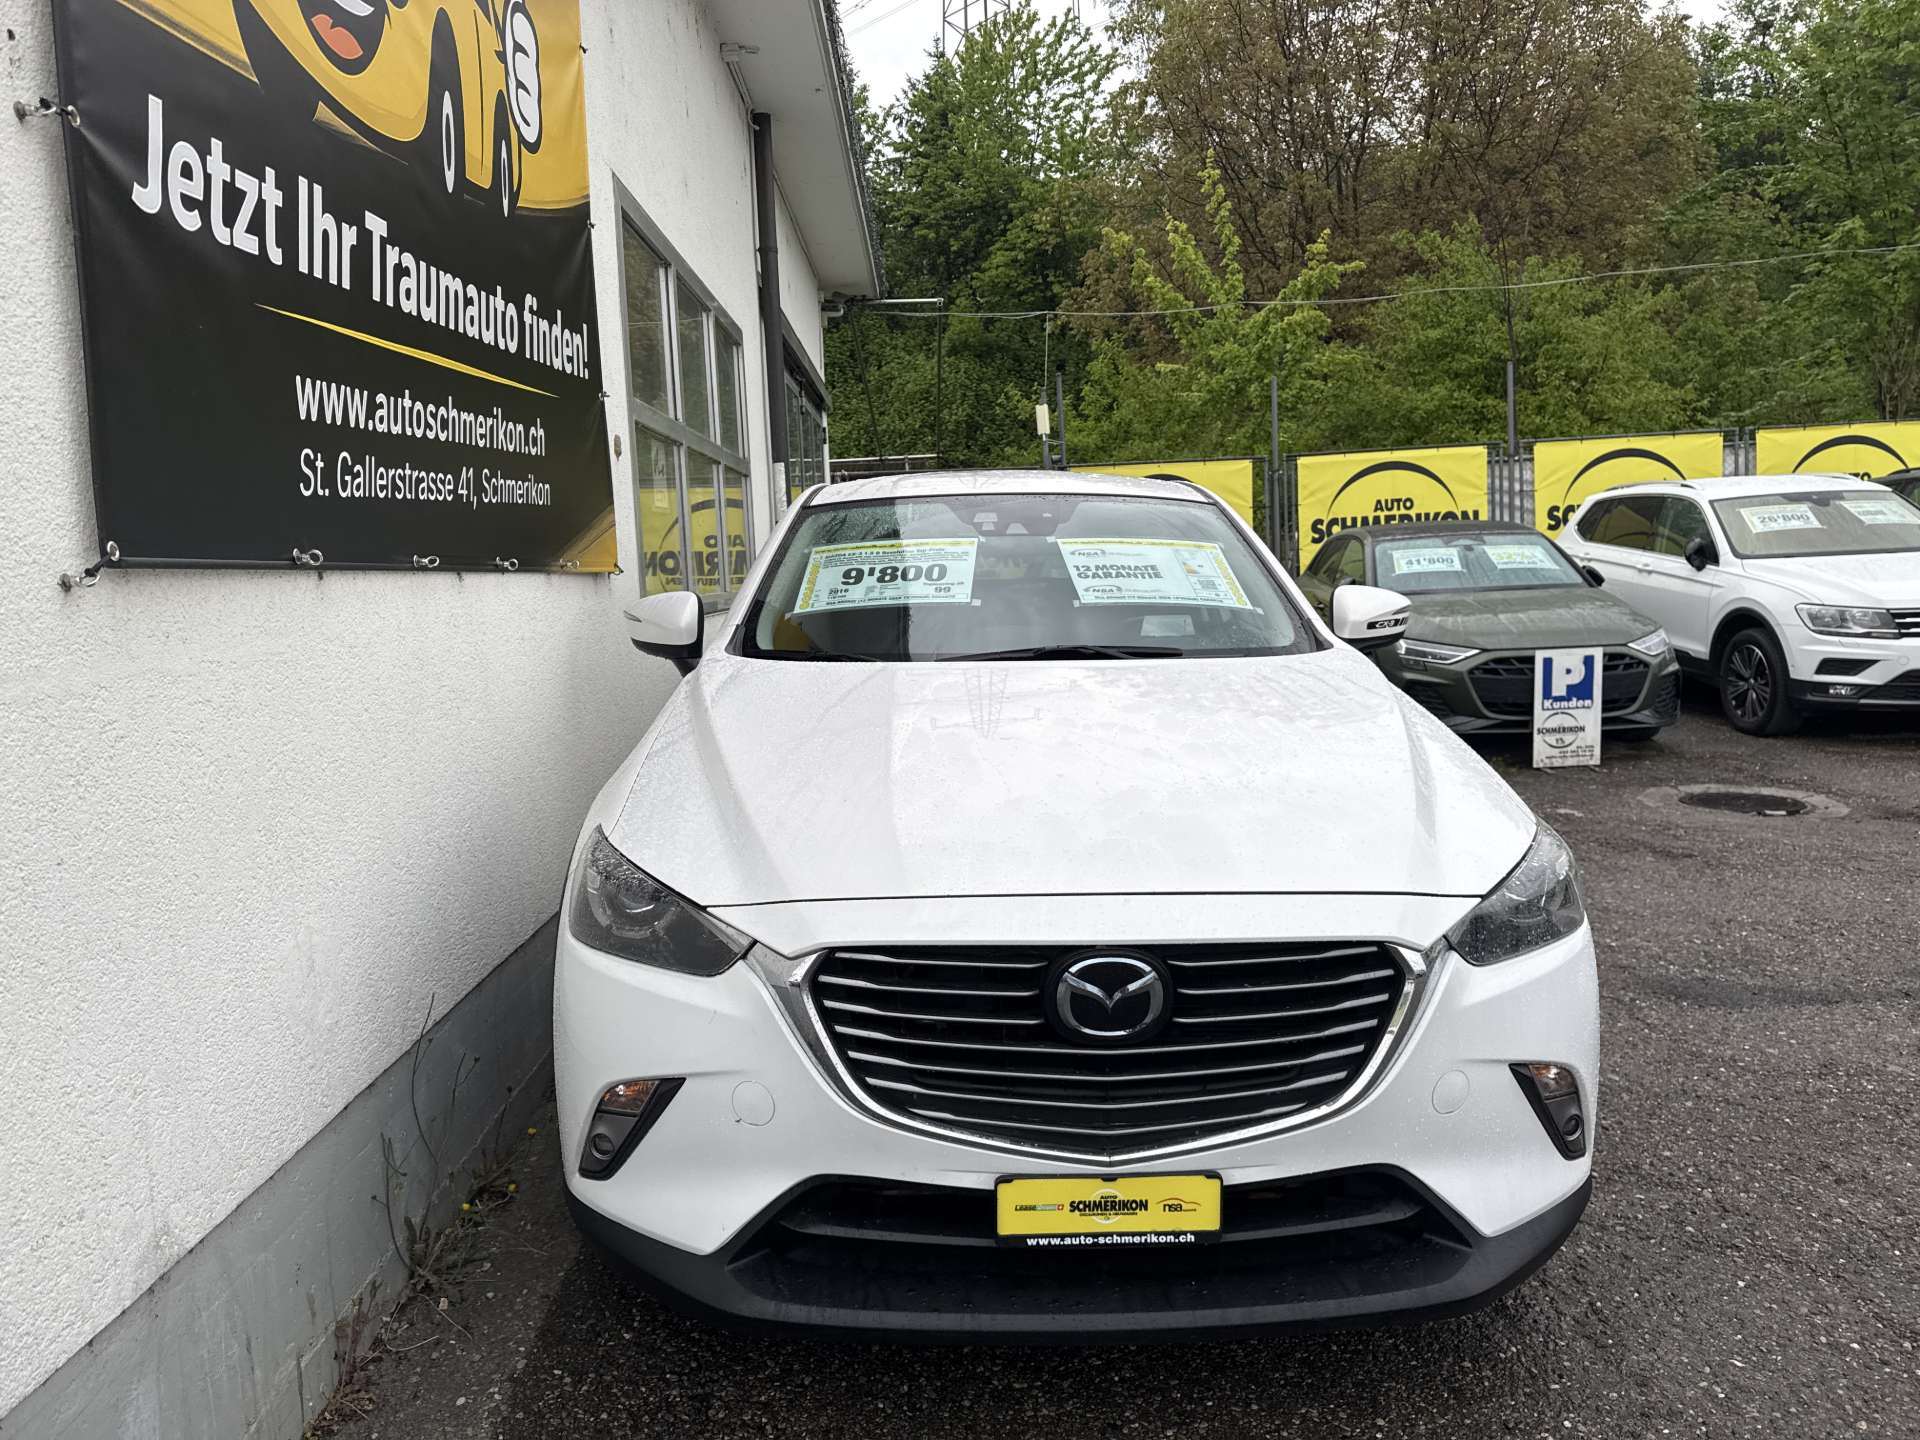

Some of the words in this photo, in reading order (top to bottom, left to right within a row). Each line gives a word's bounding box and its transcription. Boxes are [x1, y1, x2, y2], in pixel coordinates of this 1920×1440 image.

[131, 94, 283, 266] Jetzt
[298, 175, 357, 291] Ihr
[364, 210, 518, 354] Traumauto
[523, 292, 589, 379] finden!
[295, 374, 546, 457] www.autoschmerikon.ch
[300, 448, 329, 497] St.
[336, 455, 455, 503] Gallerstrasse
[458, 473, 478, 510] 41,
[482, 473, 551, 506] Schmerikon
[1374, 498, 1414, 512] AUTO
[841, 563, 948, 586] 9'800
[1094, 564, 1159, 572] MONATE
[1077, 571, 1164, 580] GARANTIE
[1552, 656, 1585, 696] P
[1543, 698, 1593, 709] Kunden
[1536, 725, 1585, 735] SCHMERIKON
[1069, 1199, 1149, 1213] SCHMERIKON
[1163, 1203, 1183, 1213] nsa
[1026, 1233, 1195, 1246] www.auto-schmerikon.ch
